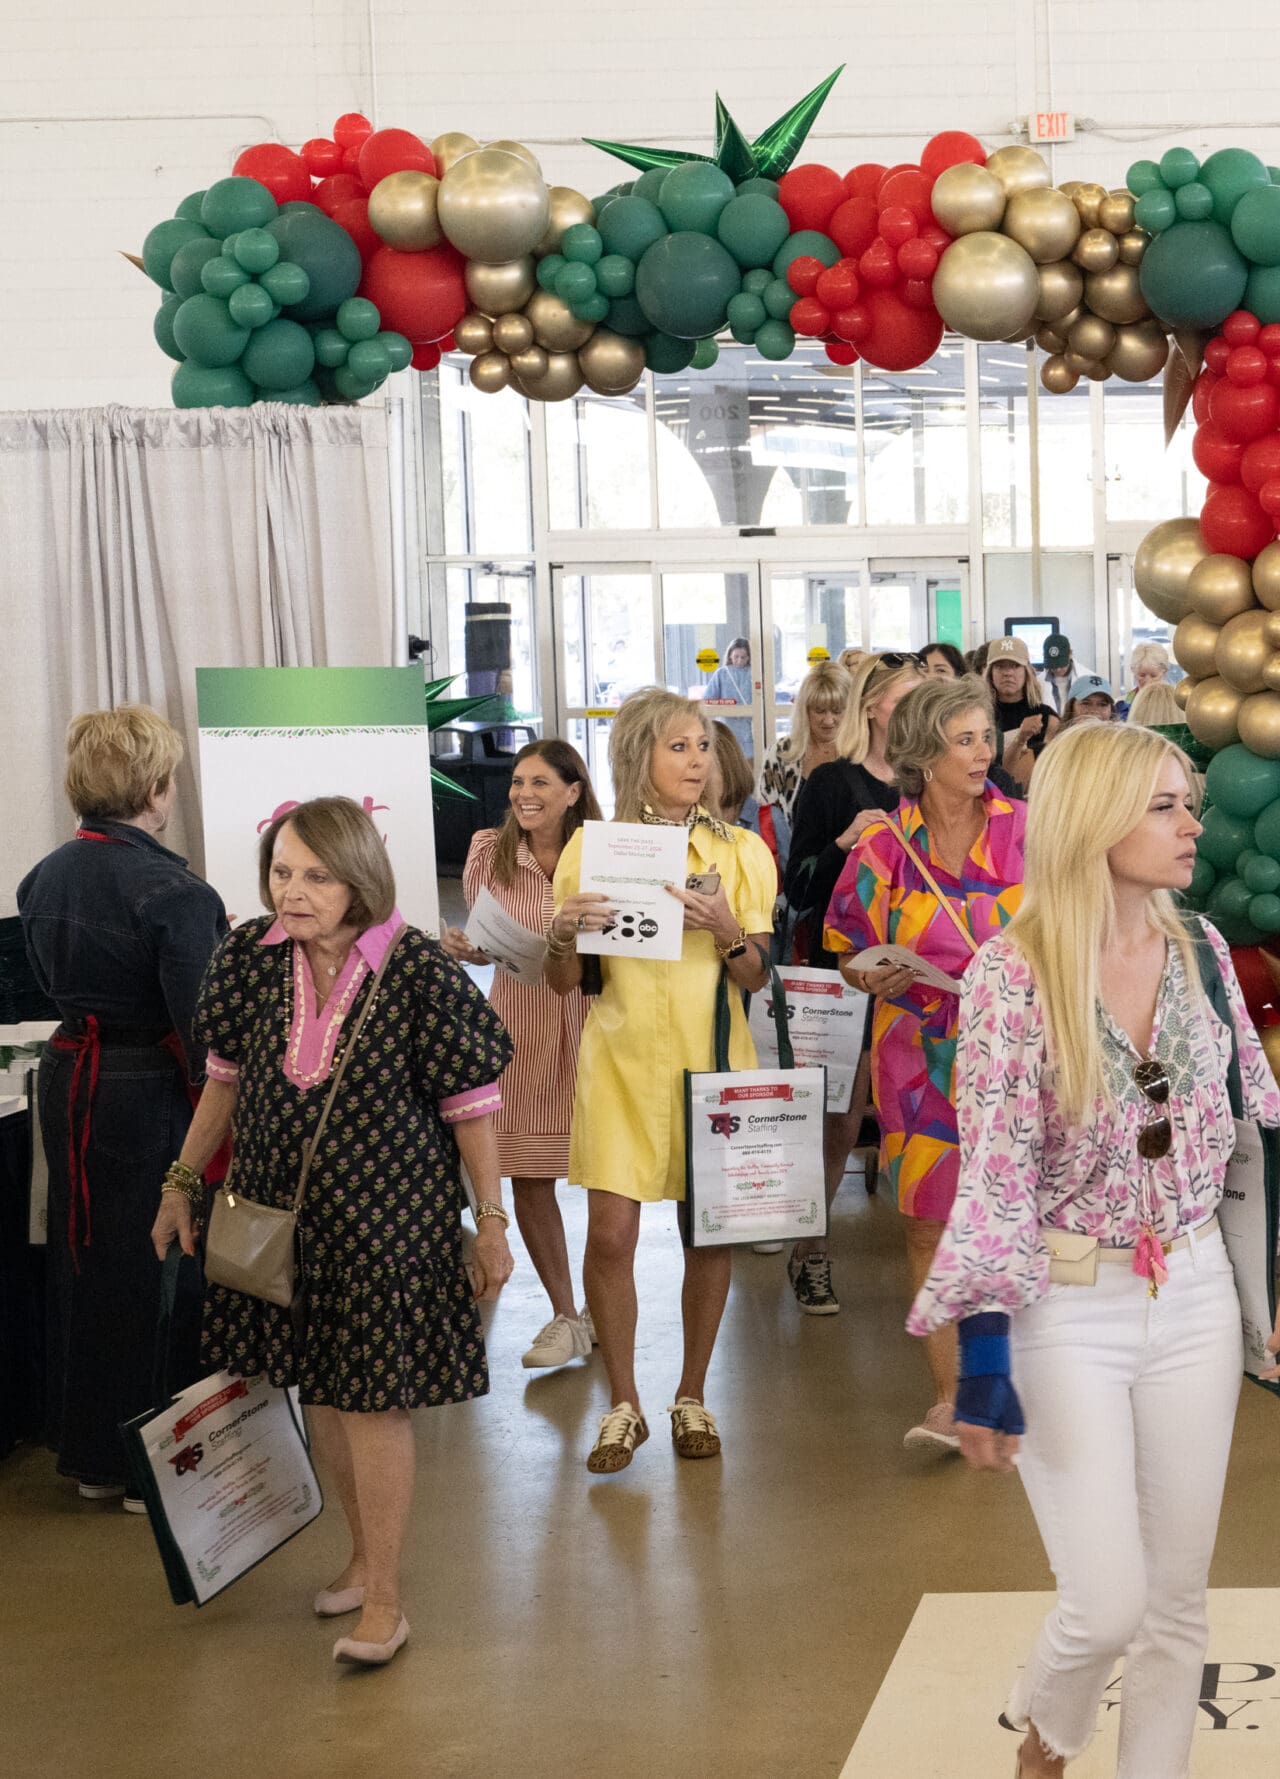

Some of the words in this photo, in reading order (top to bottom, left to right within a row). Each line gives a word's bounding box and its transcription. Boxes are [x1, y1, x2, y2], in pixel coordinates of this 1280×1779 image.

[1036, 111, 1068, 138] EXIT
[802, 1006, 853, 1017] CornerStone
[748, 1113, 807, 1124] CornerStone
[747, 1123, 778, 1134] Staffing
[208, 1400, 269, 1441] CornerStone
